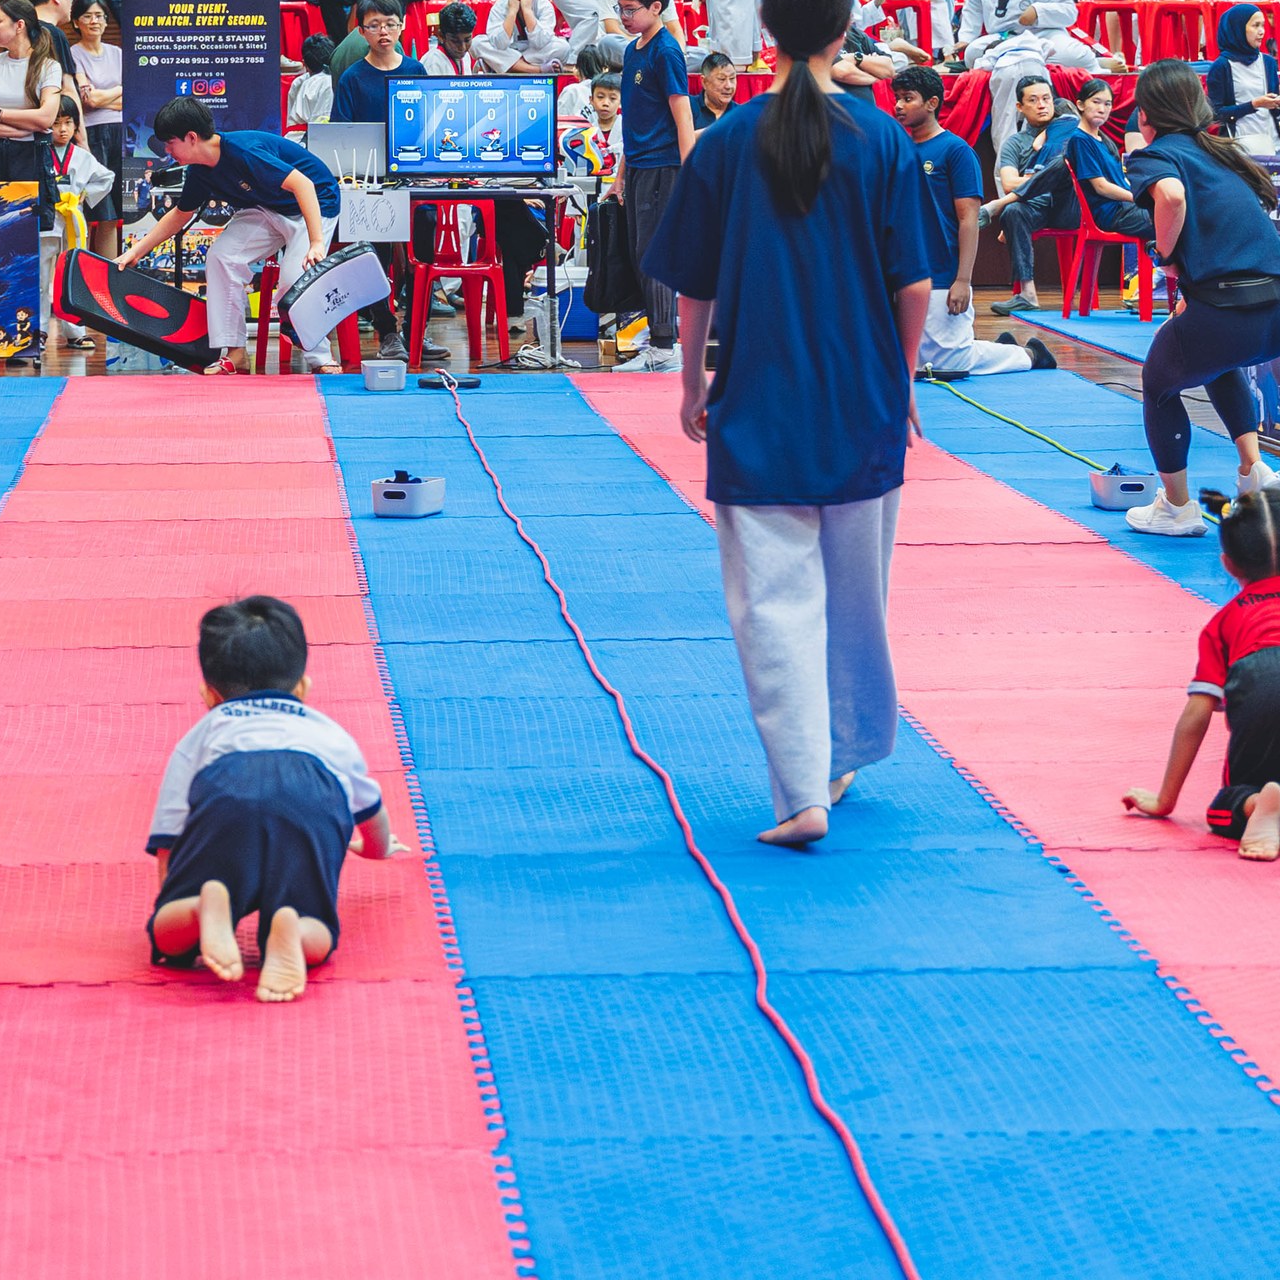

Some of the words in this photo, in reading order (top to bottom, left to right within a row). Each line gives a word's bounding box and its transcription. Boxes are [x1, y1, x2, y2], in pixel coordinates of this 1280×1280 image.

[169, 3, 195, 14] YOUR
[196, 3, 230, 14] EVENT.
[133, 16, 154, 27] OUR
[157, 16, 193, 27] WATCH.
[195, 15, 225, 26] EVERY
[227, 15, 267, 26] SECOND.
[135, 35, 174, 43] MEDICAL
[200, 43, 237, 51] Occasions
[160, 57, 174, 65] 017
[405, 108, 414, 121] 0
[446, 108, 455, 121] 0
[487, 108, 496, 121] 0
[528, 107, 537, 121] 0
